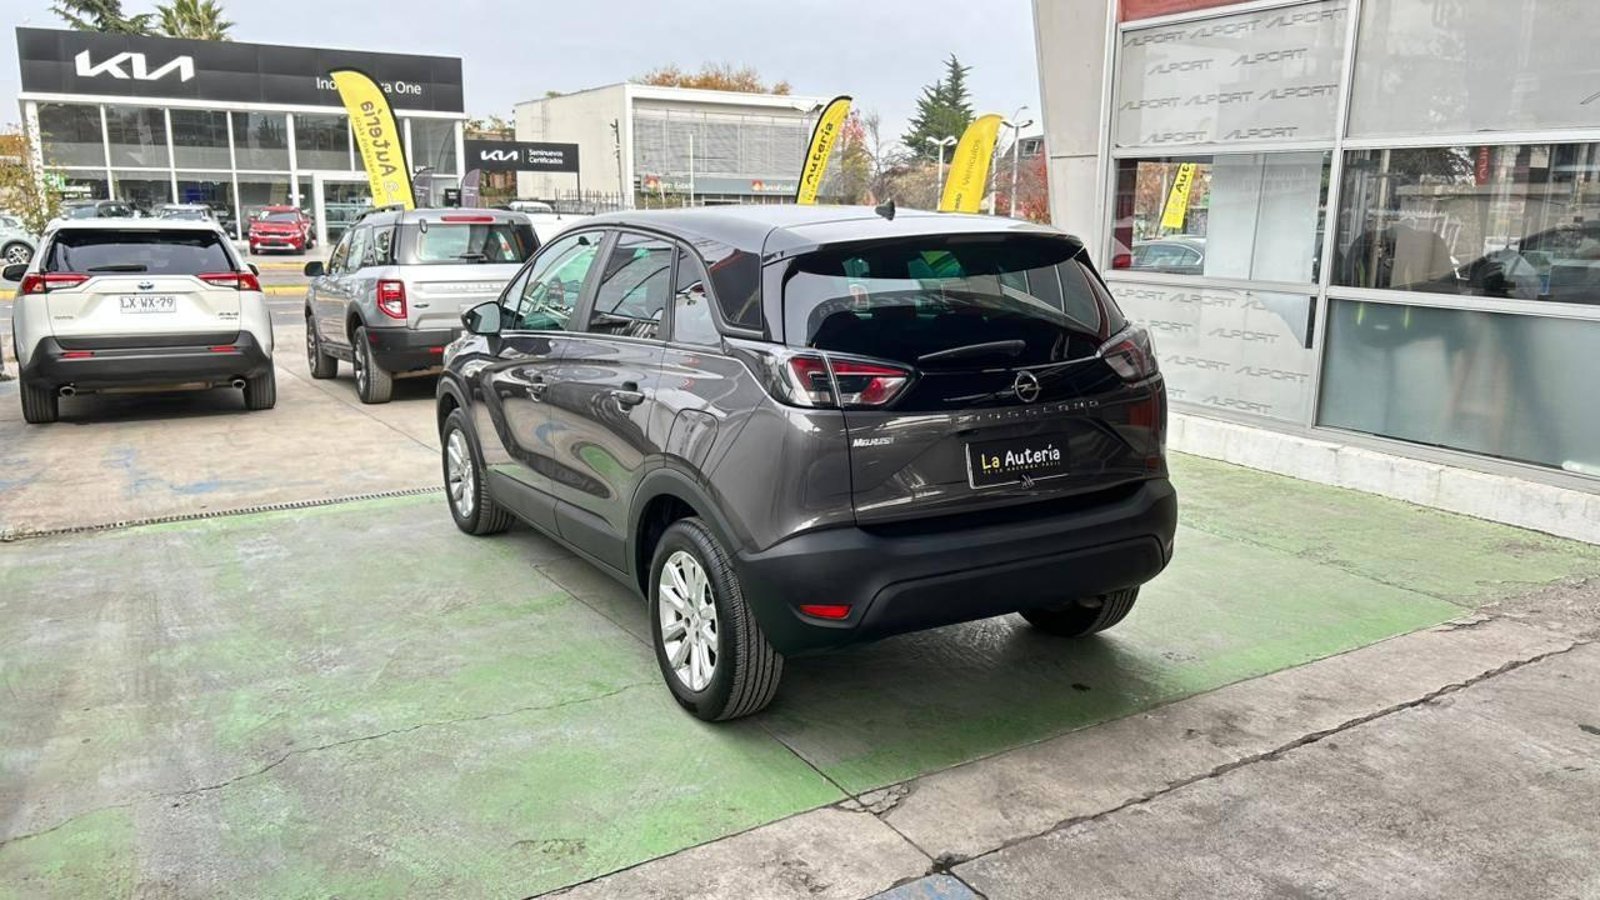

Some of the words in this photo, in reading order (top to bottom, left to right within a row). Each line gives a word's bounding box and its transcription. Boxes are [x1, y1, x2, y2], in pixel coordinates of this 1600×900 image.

[74, 49, 195, 83] KIA
[395, 82, 421, 95] One
[480, 150, 518, 160] KIA
[528, 149, 563, 157] Seminuevos
[528, 156, 563, 165] Certificados
[981, 453, 1000, 470] La
[1005, 444, 1060, 467] Autería
